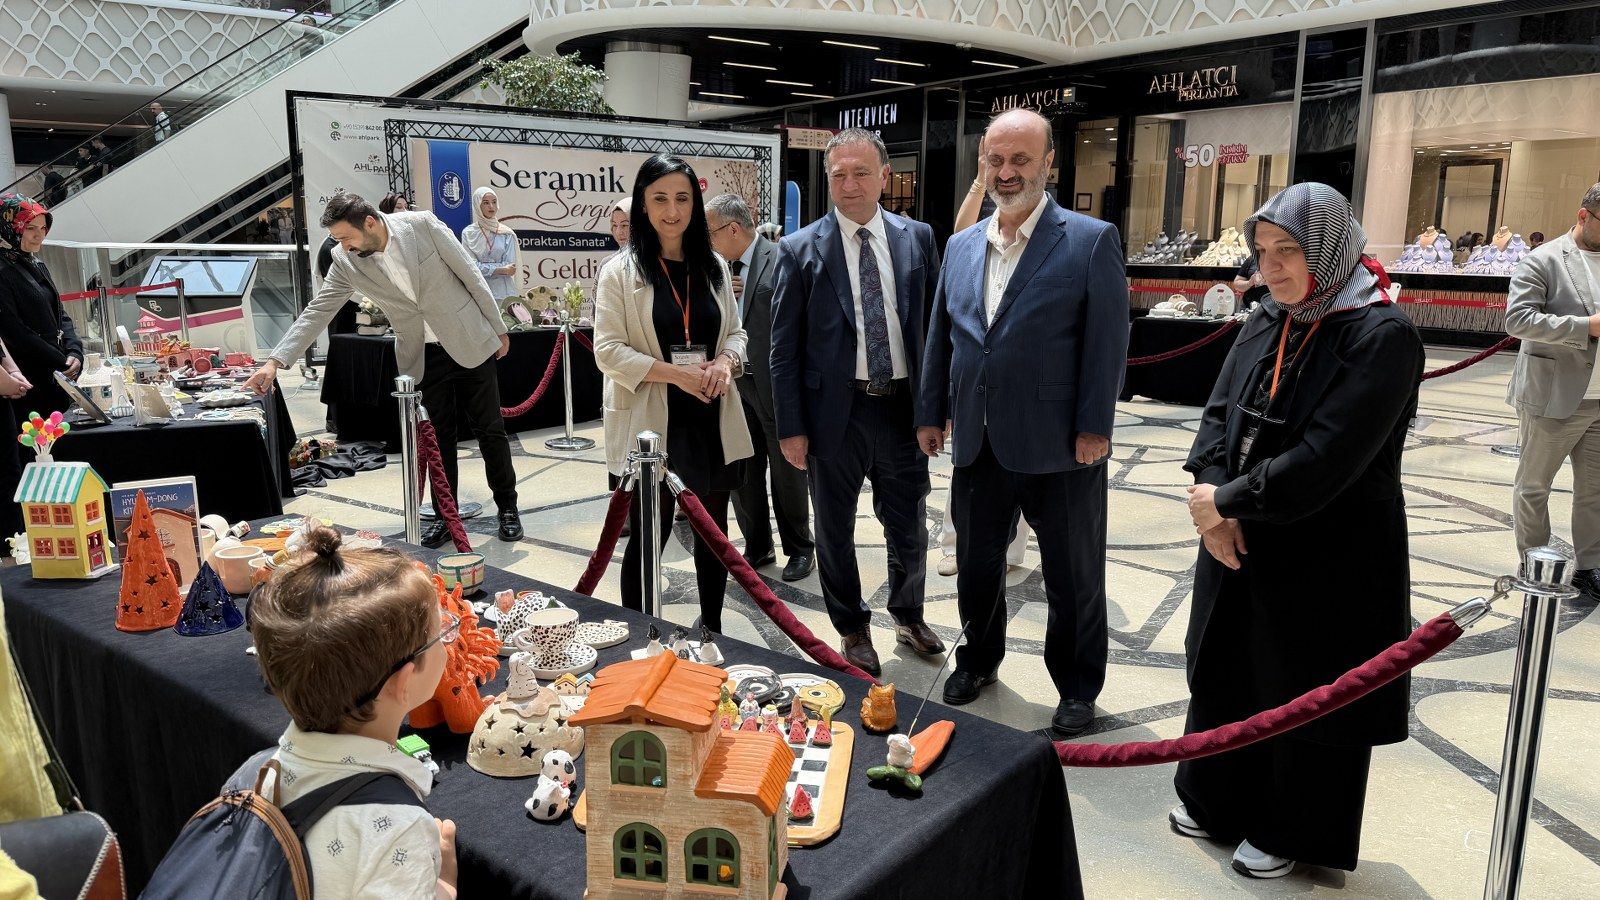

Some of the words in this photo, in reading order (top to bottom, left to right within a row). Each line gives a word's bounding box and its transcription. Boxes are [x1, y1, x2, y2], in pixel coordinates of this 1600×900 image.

[1147, 65, 1238, 94] AHLATCI
[839, 103, 898, 130] INTERVIEW
[490, 158, 626, 193] Seramik
[536, 187, 612, 231] Sergi
[516, 236, 566, 247] opraktan
[568, 237, 610, 247] Sanata"
[537, 257, 598, 280] Geldi
[122, 493, 178, 505] HYUM-DONG
